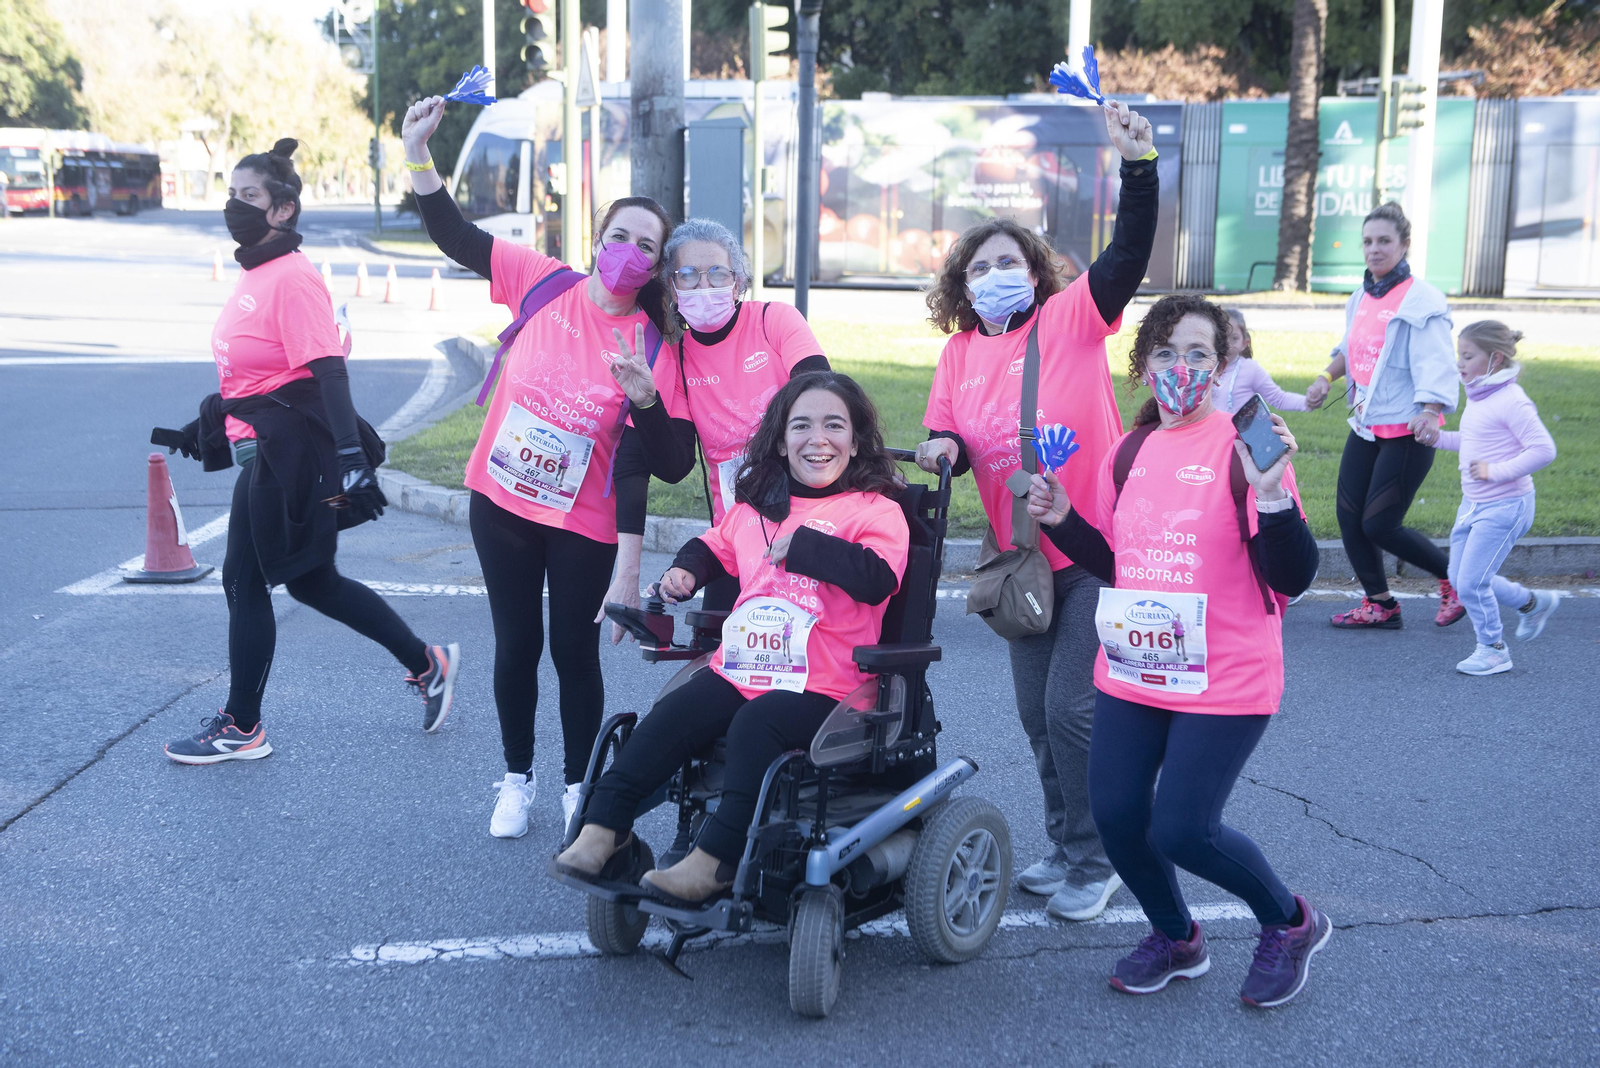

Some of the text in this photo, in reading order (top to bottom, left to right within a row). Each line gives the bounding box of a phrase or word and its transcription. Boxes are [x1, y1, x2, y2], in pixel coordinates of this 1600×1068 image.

[1325, 164, 1355, 188] TU
[1254, 192, 1279, 209] DE
[550, 311, 580, 338] OYSHO
[554, 398, 597, 430] TODAS
[575, 395, 604, 417] POR
[526, 430, 563, 453] ASTURIANA
[520, 447, 558, 473] 016
[489, 466, 513, 486] OYSHO
[502, 464, 526, 480] CARRERA
[525, 476, 535, 484] DE
[533, 479, 541, 487] LA
[541, 483, 561, 494] MUJER
[525, 468, 541, 478] 467
[1164, 531, 1197, 546] POR
[1145, 549, 1195, 565] TODAS
[1121, 565, 1194, 584] NOSOTRAS
[789, 575, 819, 592] POR
[750, 611, 786, 622] ASTURIANA
[1128, 608, 1171, 620] ASTURIANA
[747, 632, 781, 650] 016
[1128, 630, 1173, 649] 016
[754, 653, 770, 662] 468
[1121, 658, 1146, 667] CARRERA
[1141, 653, 1159, 661] 465
[1112, 666, 1139, 679] OYSHO
